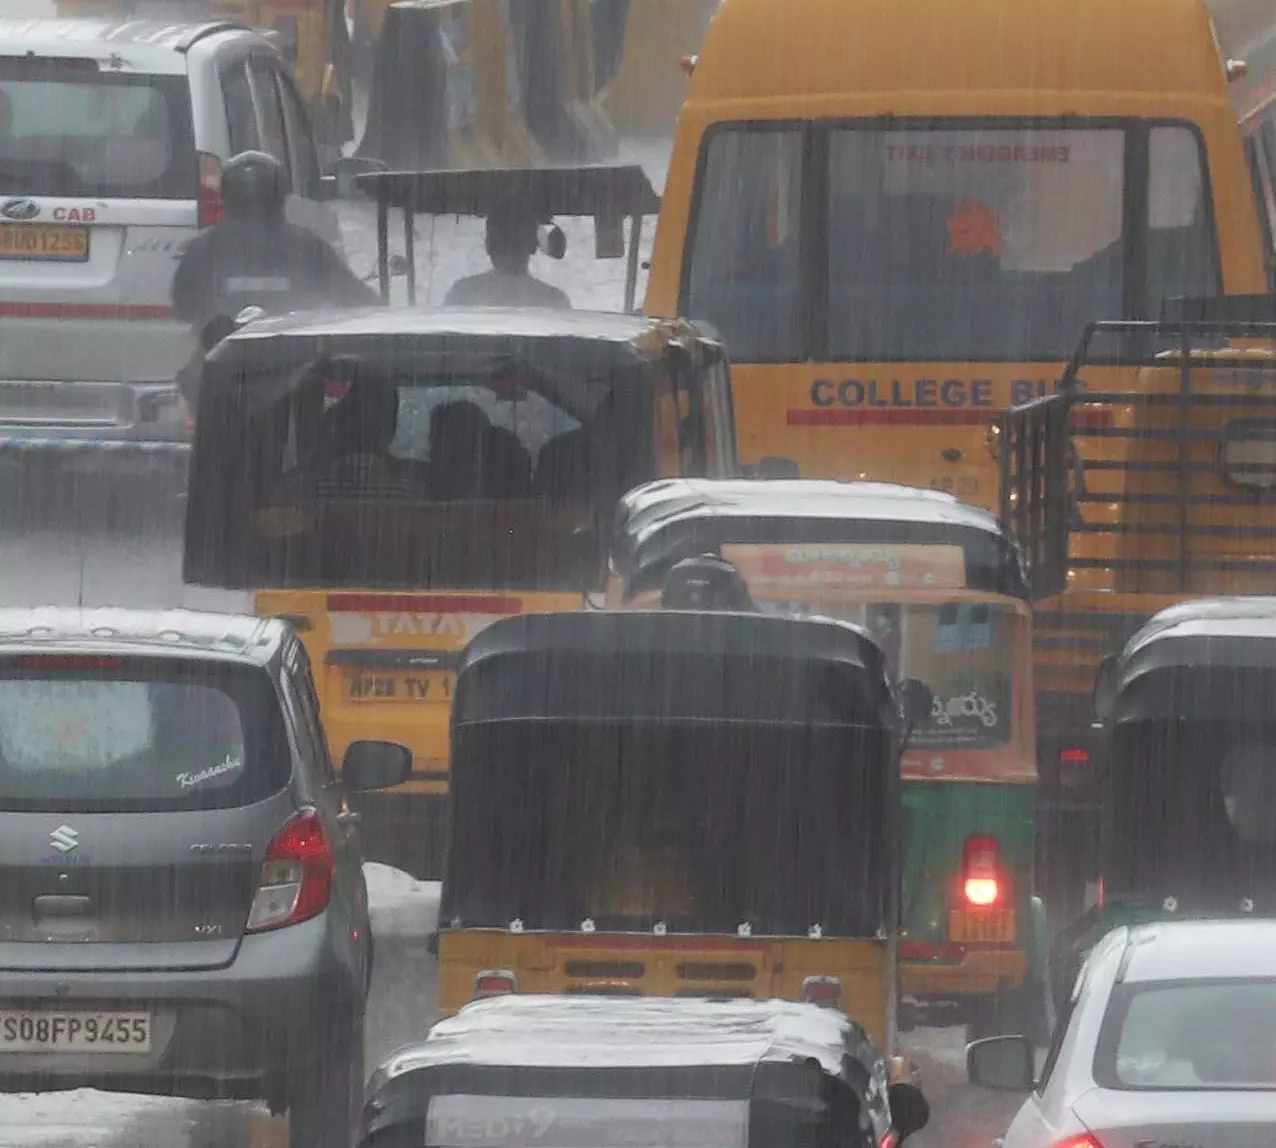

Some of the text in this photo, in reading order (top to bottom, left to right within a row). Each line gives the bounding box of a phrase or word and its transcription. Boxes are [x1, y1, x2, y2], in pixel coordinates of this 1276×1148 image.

[53, 207, 96, 222] CAB
[811, 379, 992, 408] COLLEGE
[375, 614, 460, 635] TATA
[404, 678, 430, 698] TV
